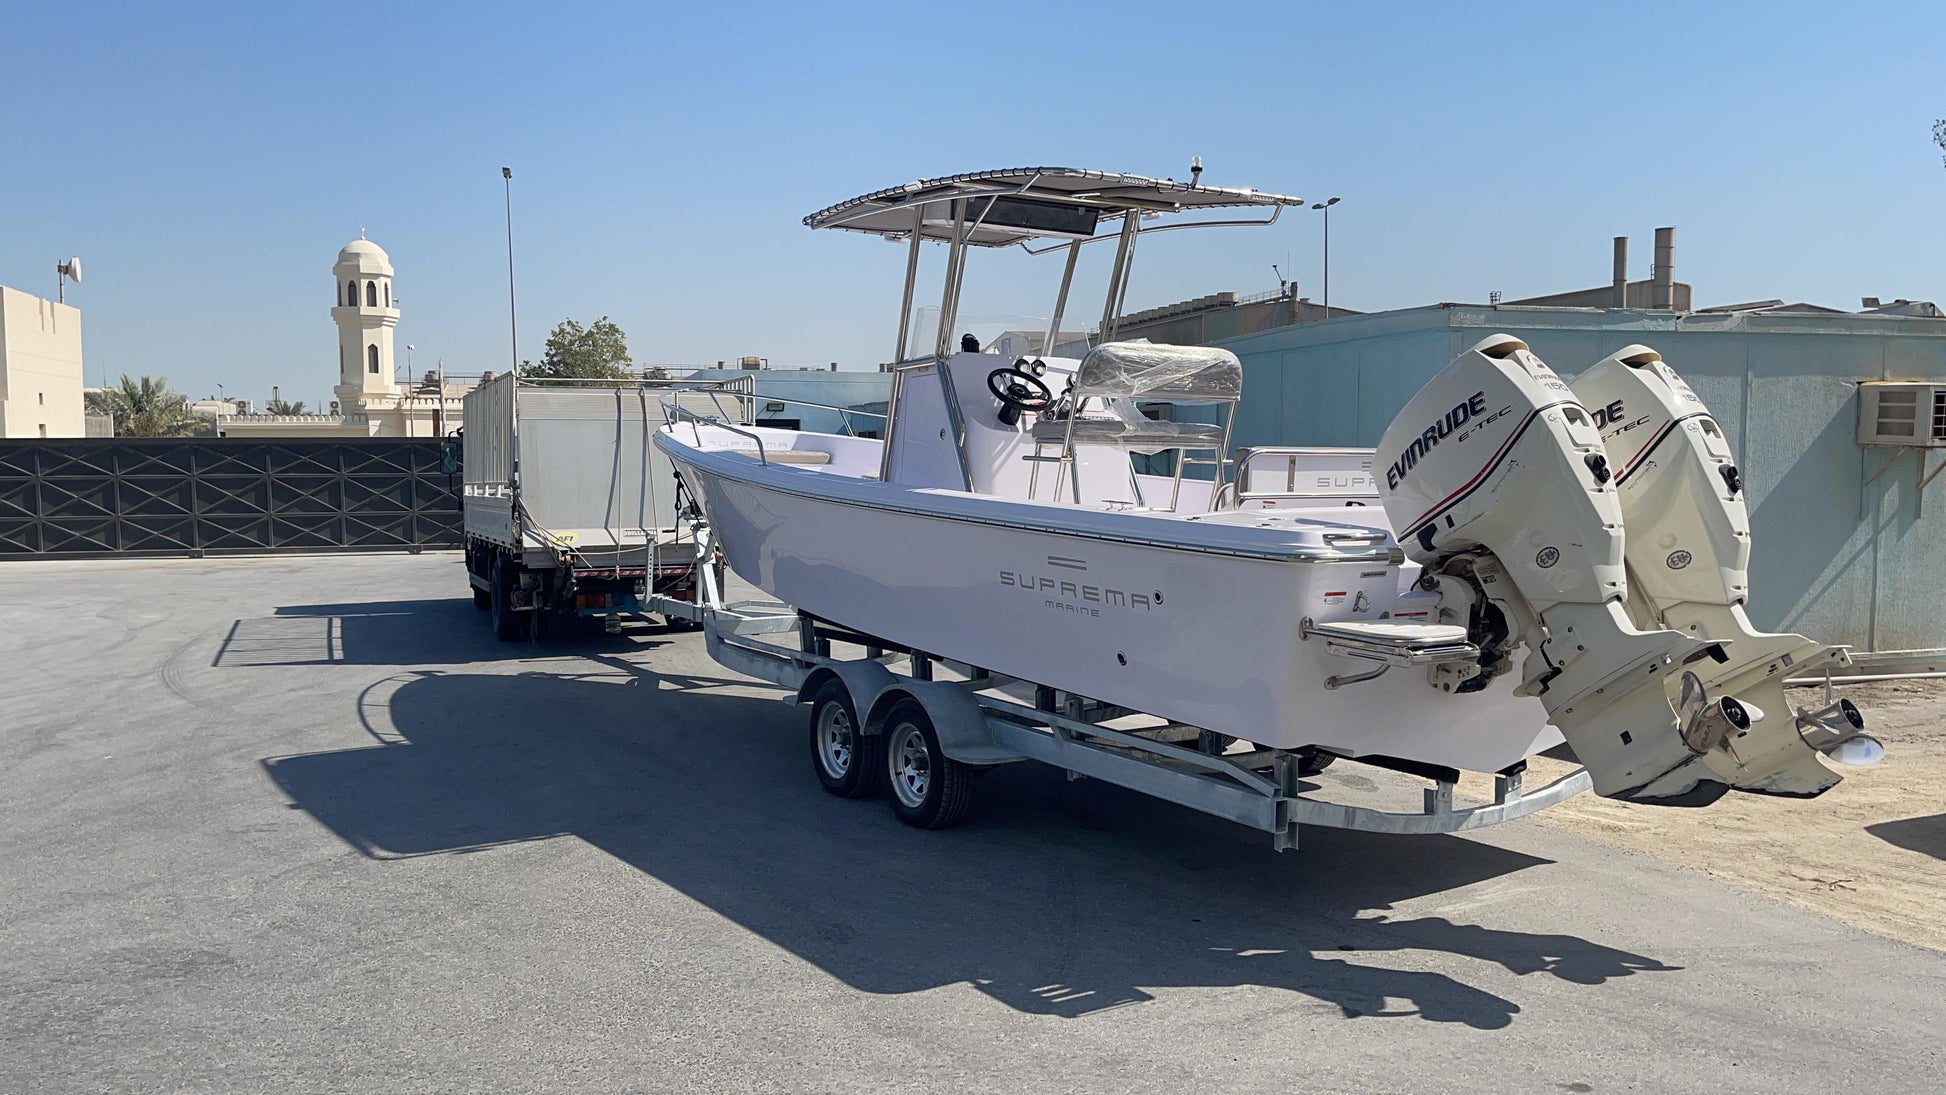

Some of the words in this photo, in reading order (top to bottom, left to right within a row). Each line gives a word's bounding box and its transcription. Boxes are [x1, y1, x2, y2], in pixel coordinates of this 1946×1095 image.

[1386, 390, 1486, 491] EVINRUDE
[1459, 405, 1512, 442] E-TEC
[1000, 571, 1150, 611] SUPREMA
[1045, 600, 1100, 617] MARINE
